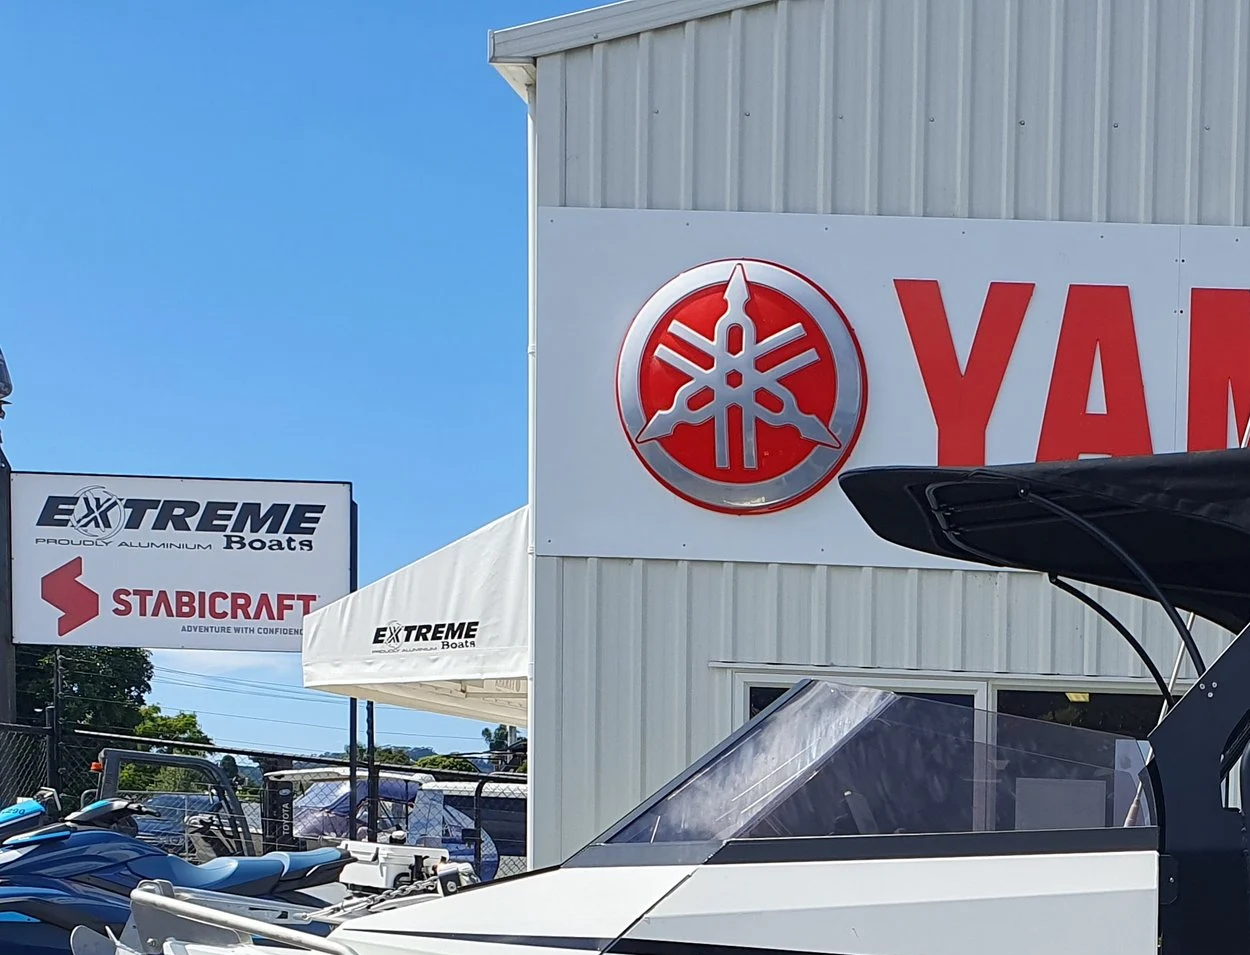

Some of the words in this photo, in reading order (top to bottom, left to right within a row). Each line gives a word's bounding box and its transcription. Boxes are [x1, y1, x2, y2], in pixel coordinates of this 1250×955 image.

[36, 495, 326, 535] EXTREME
[35, 538, 113, 547] PROUDLY
[117, 541, 212, 550] ALUMINIUM
[223, 534, 314, 552] Boats
[112, 588, 317, 621] STABICRAFT
[181, 625, 232, 634] ADVENTURE
[233, 626, 255, 635] WITH
[257, 627, 303, 636] CONFIDENC
[372, 621, 480, 644] EXTREME
[440, 640, 476, 650] Boats
[282, 803, 290, 836] TOYOTA
